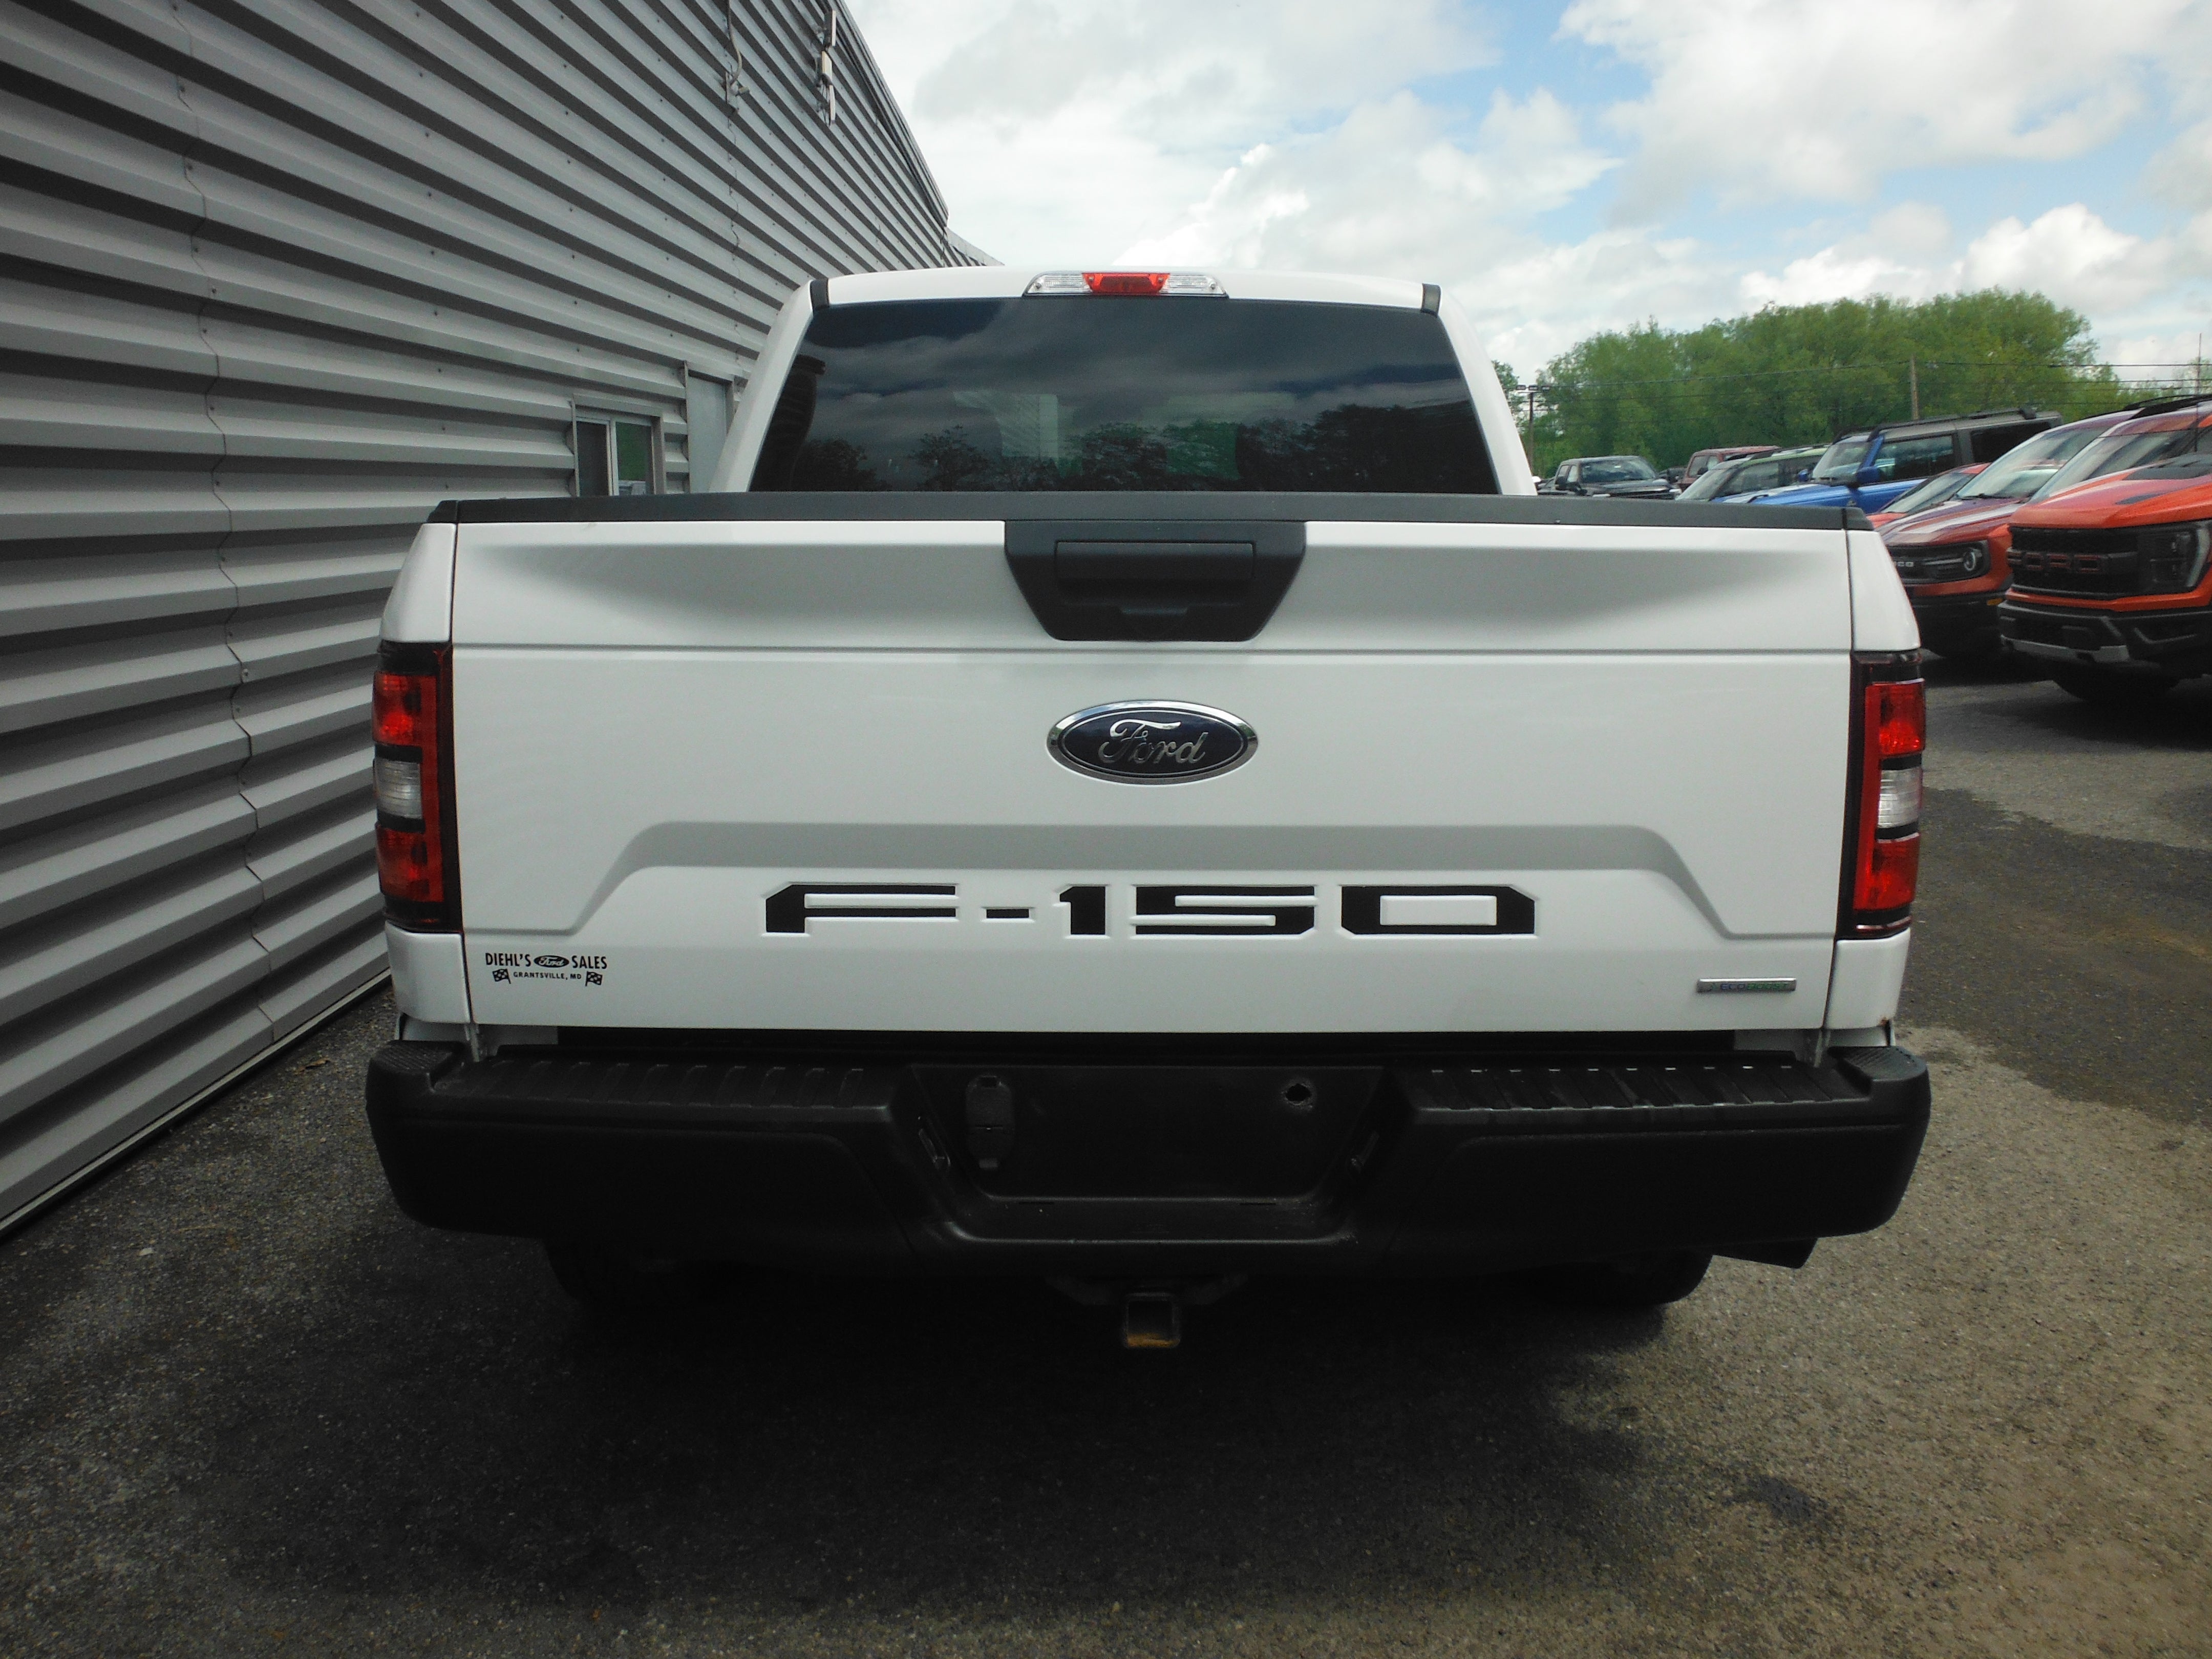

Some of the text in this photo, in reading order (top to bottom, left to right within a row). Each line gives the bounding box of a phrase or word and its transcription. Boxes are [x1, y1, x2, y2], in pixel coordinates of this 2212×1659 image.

[1097, 718, 1210, 765] Ford
[765, 883, 1536, 935] F-150
[484, 952, 608, 970] DIEHL'S Ford SALES
[513, 971, 568, 981] GRANTSVILLE,
